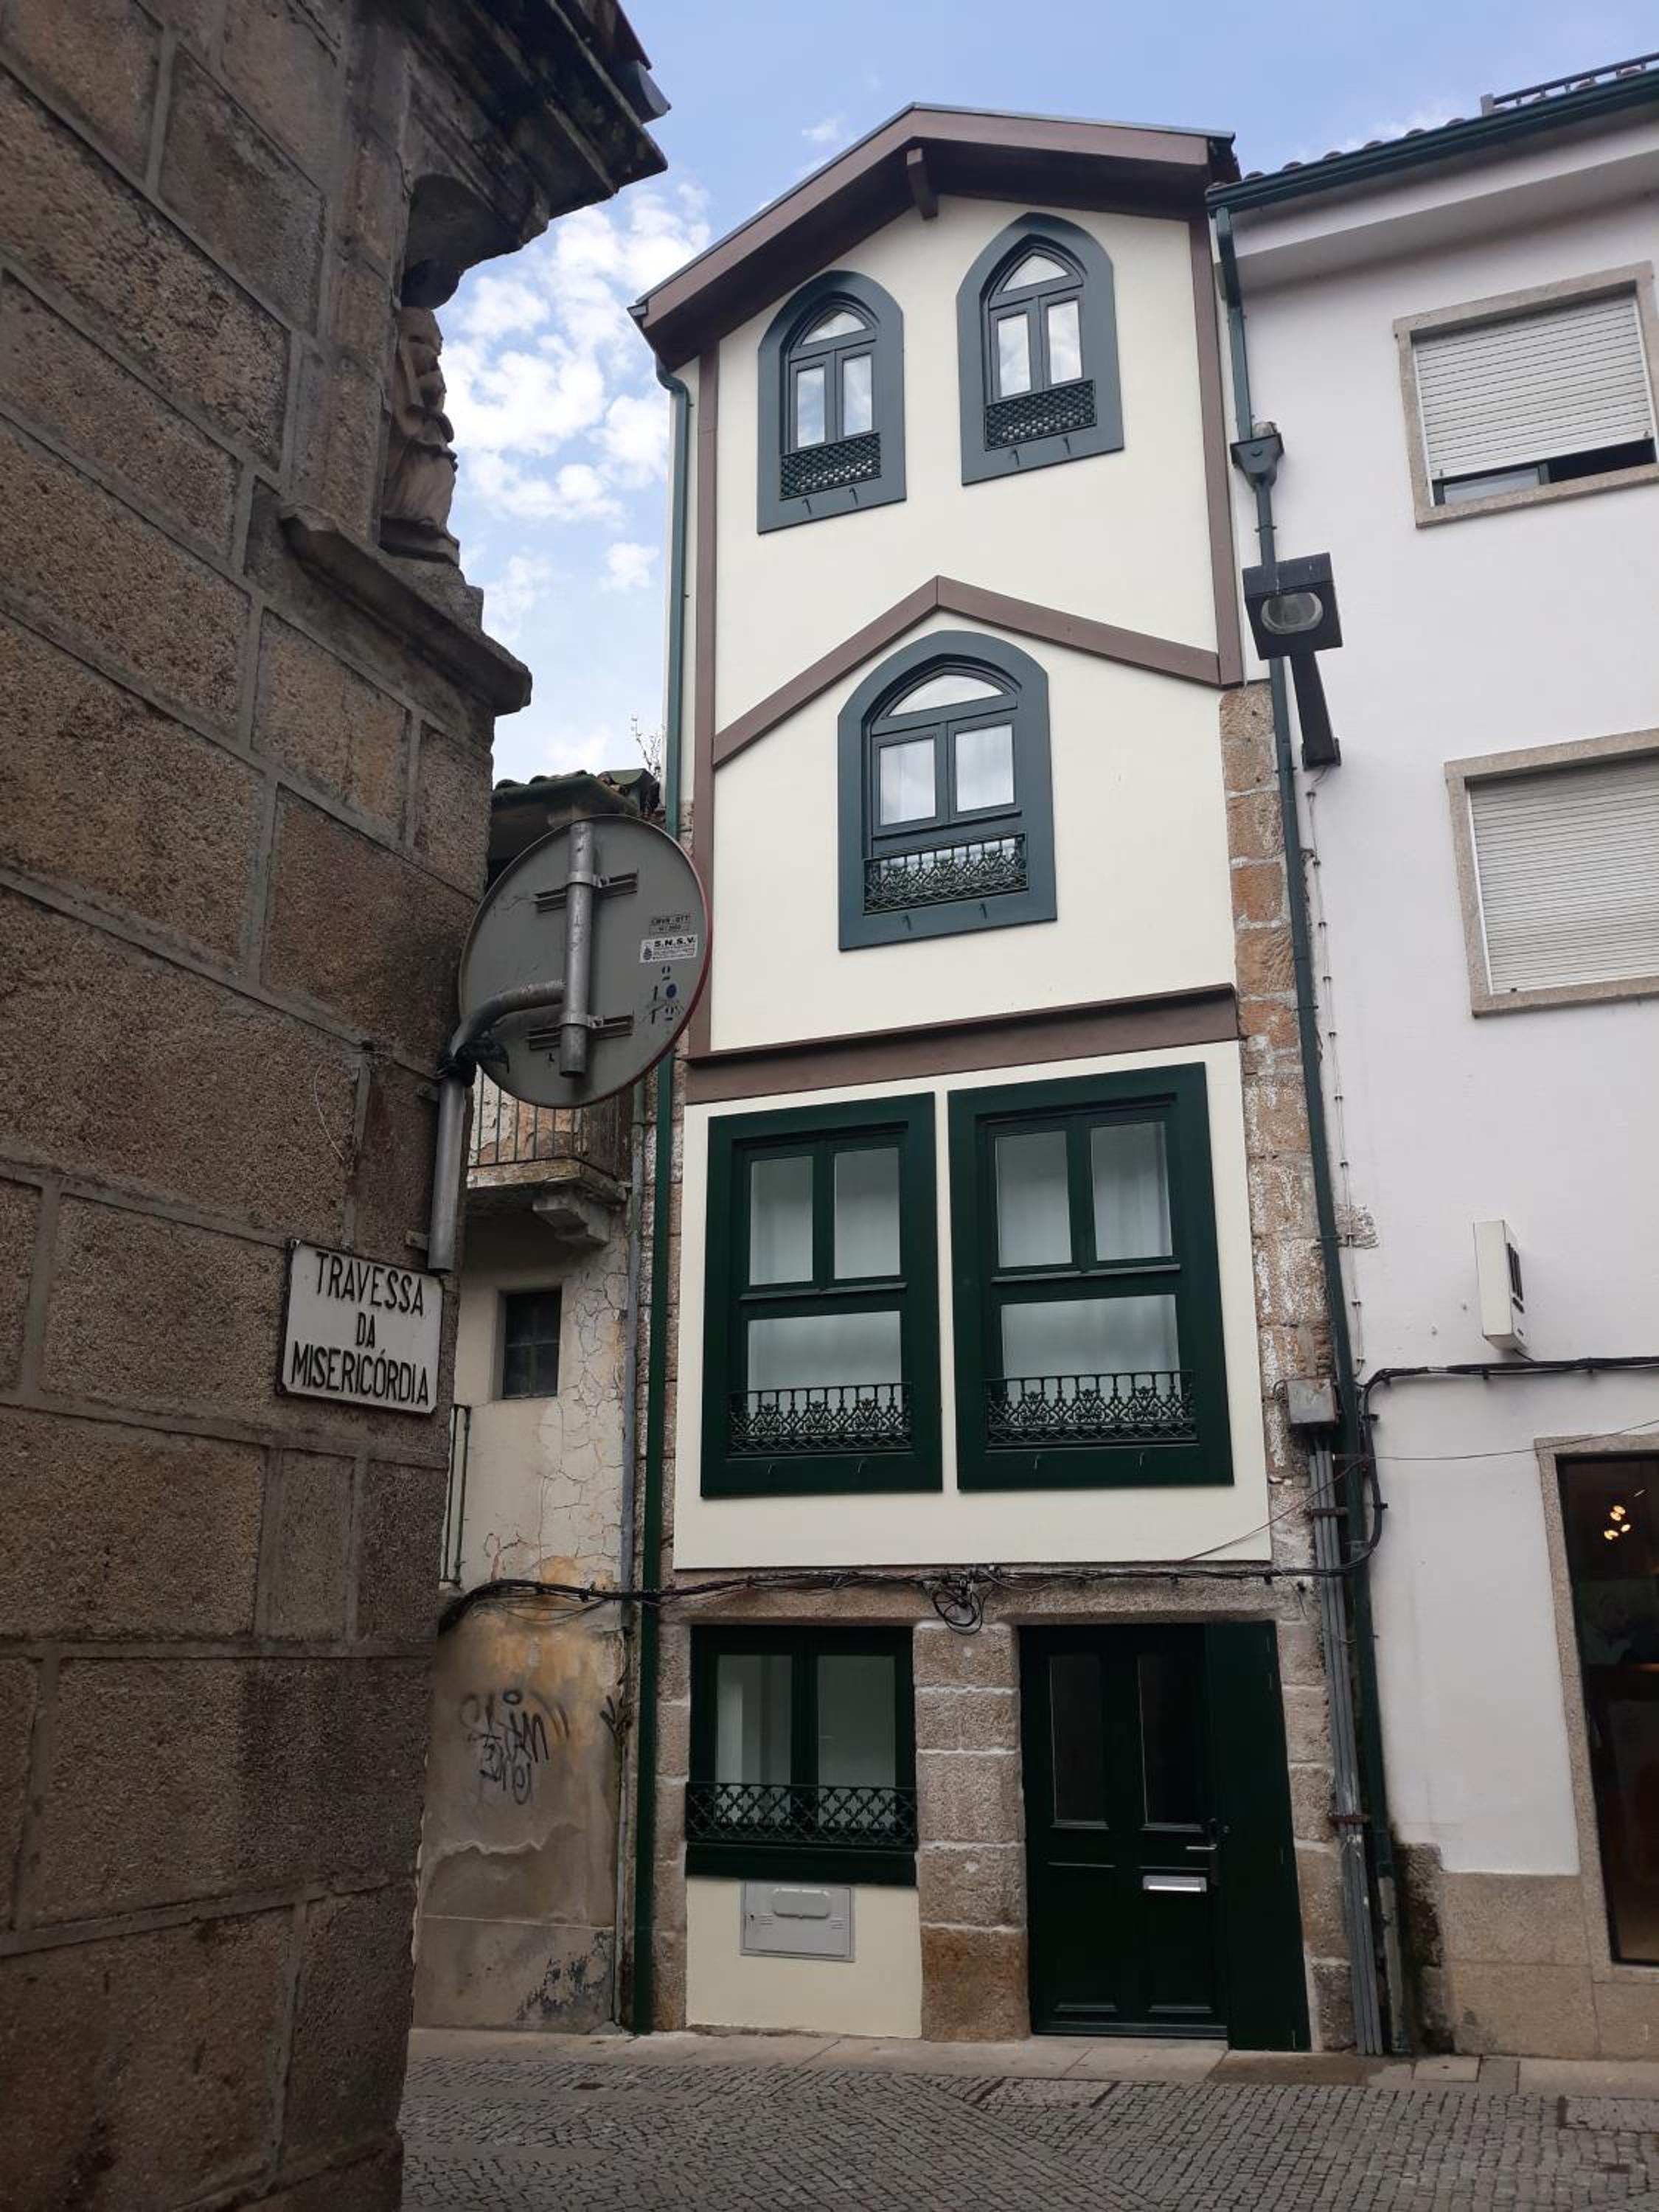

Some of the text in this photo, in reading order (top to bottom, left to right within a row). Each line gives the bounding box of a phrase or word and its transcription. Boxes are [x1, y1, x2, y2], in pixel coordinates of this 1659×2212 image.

[316, 1251, 424, 1317] TRAVESSA
[355, 1312, 375, 1349] DA
[291, 1340, 428, 1405] MISERICÓRDIA
